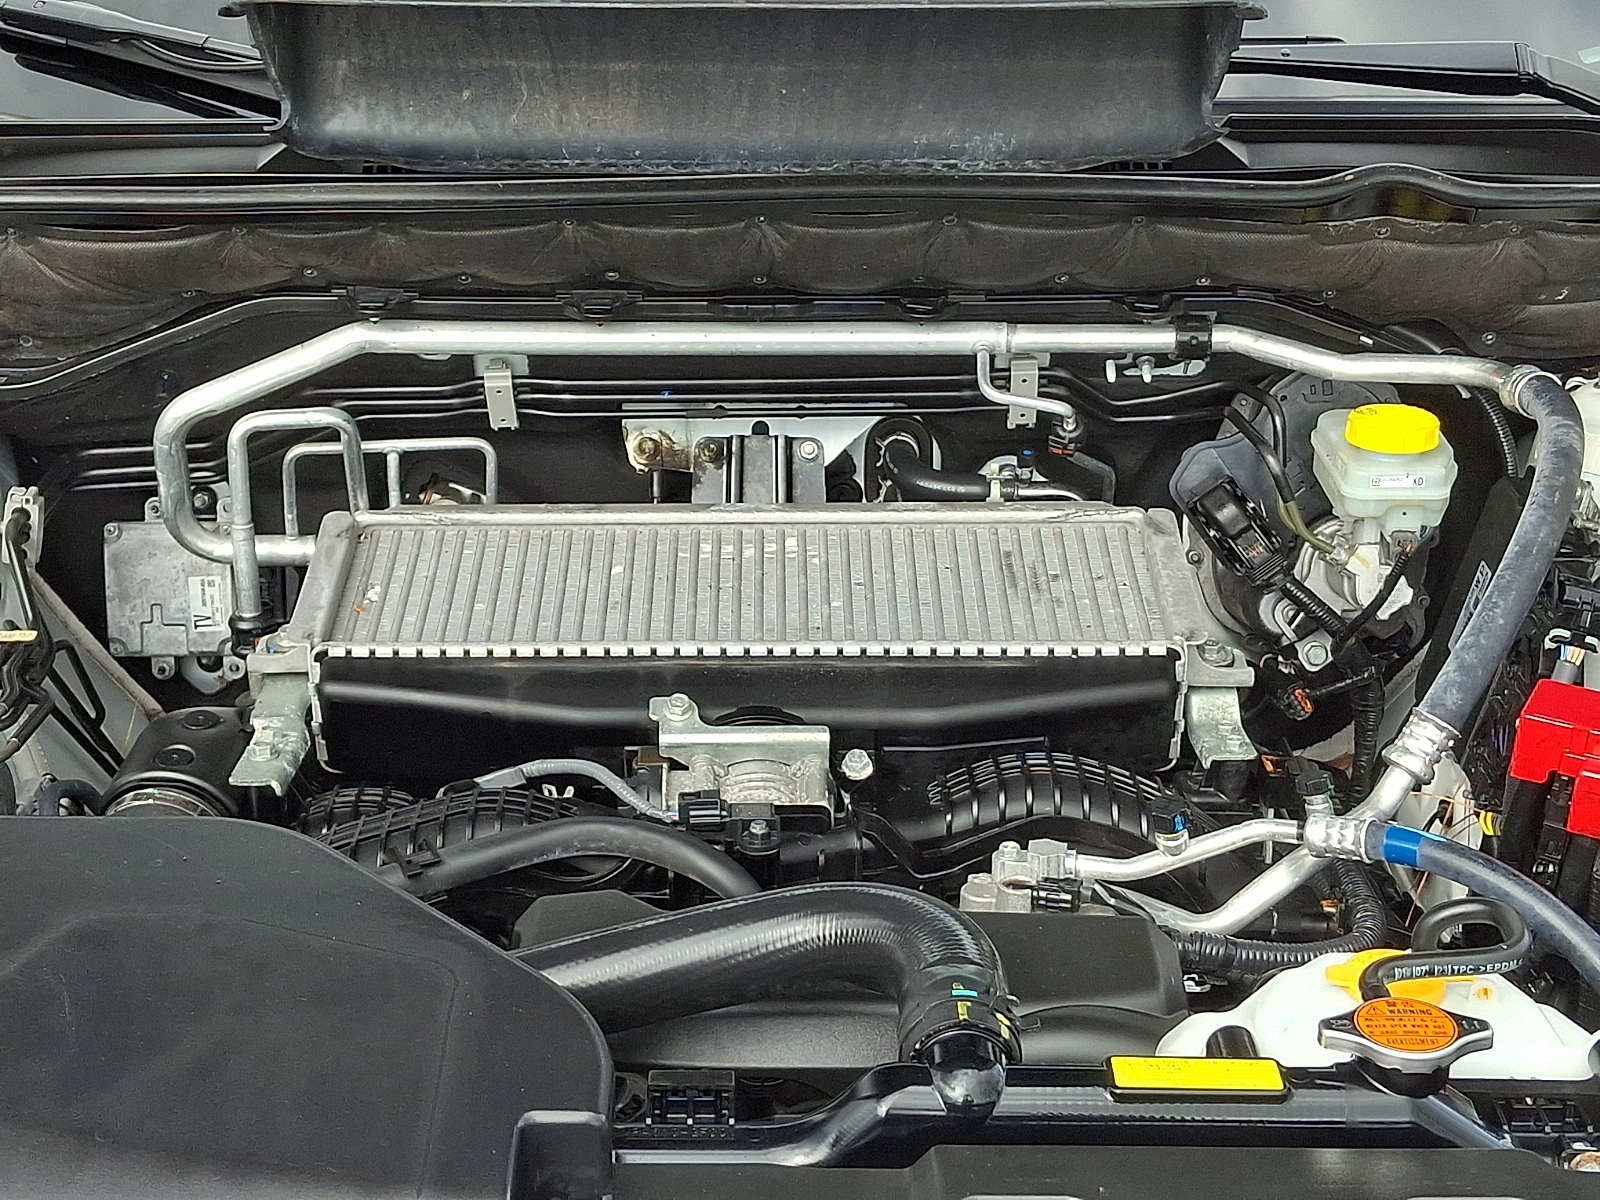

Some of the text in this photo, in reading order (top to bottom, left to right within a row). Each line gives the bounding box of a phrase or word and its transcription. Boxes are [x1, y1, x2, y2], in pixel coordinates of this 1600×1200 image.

[193, 614, 213, 630] TV
[1453, 965, 1474, 974] TPC
[1387, 1008, 1433, 1016] WARNING
